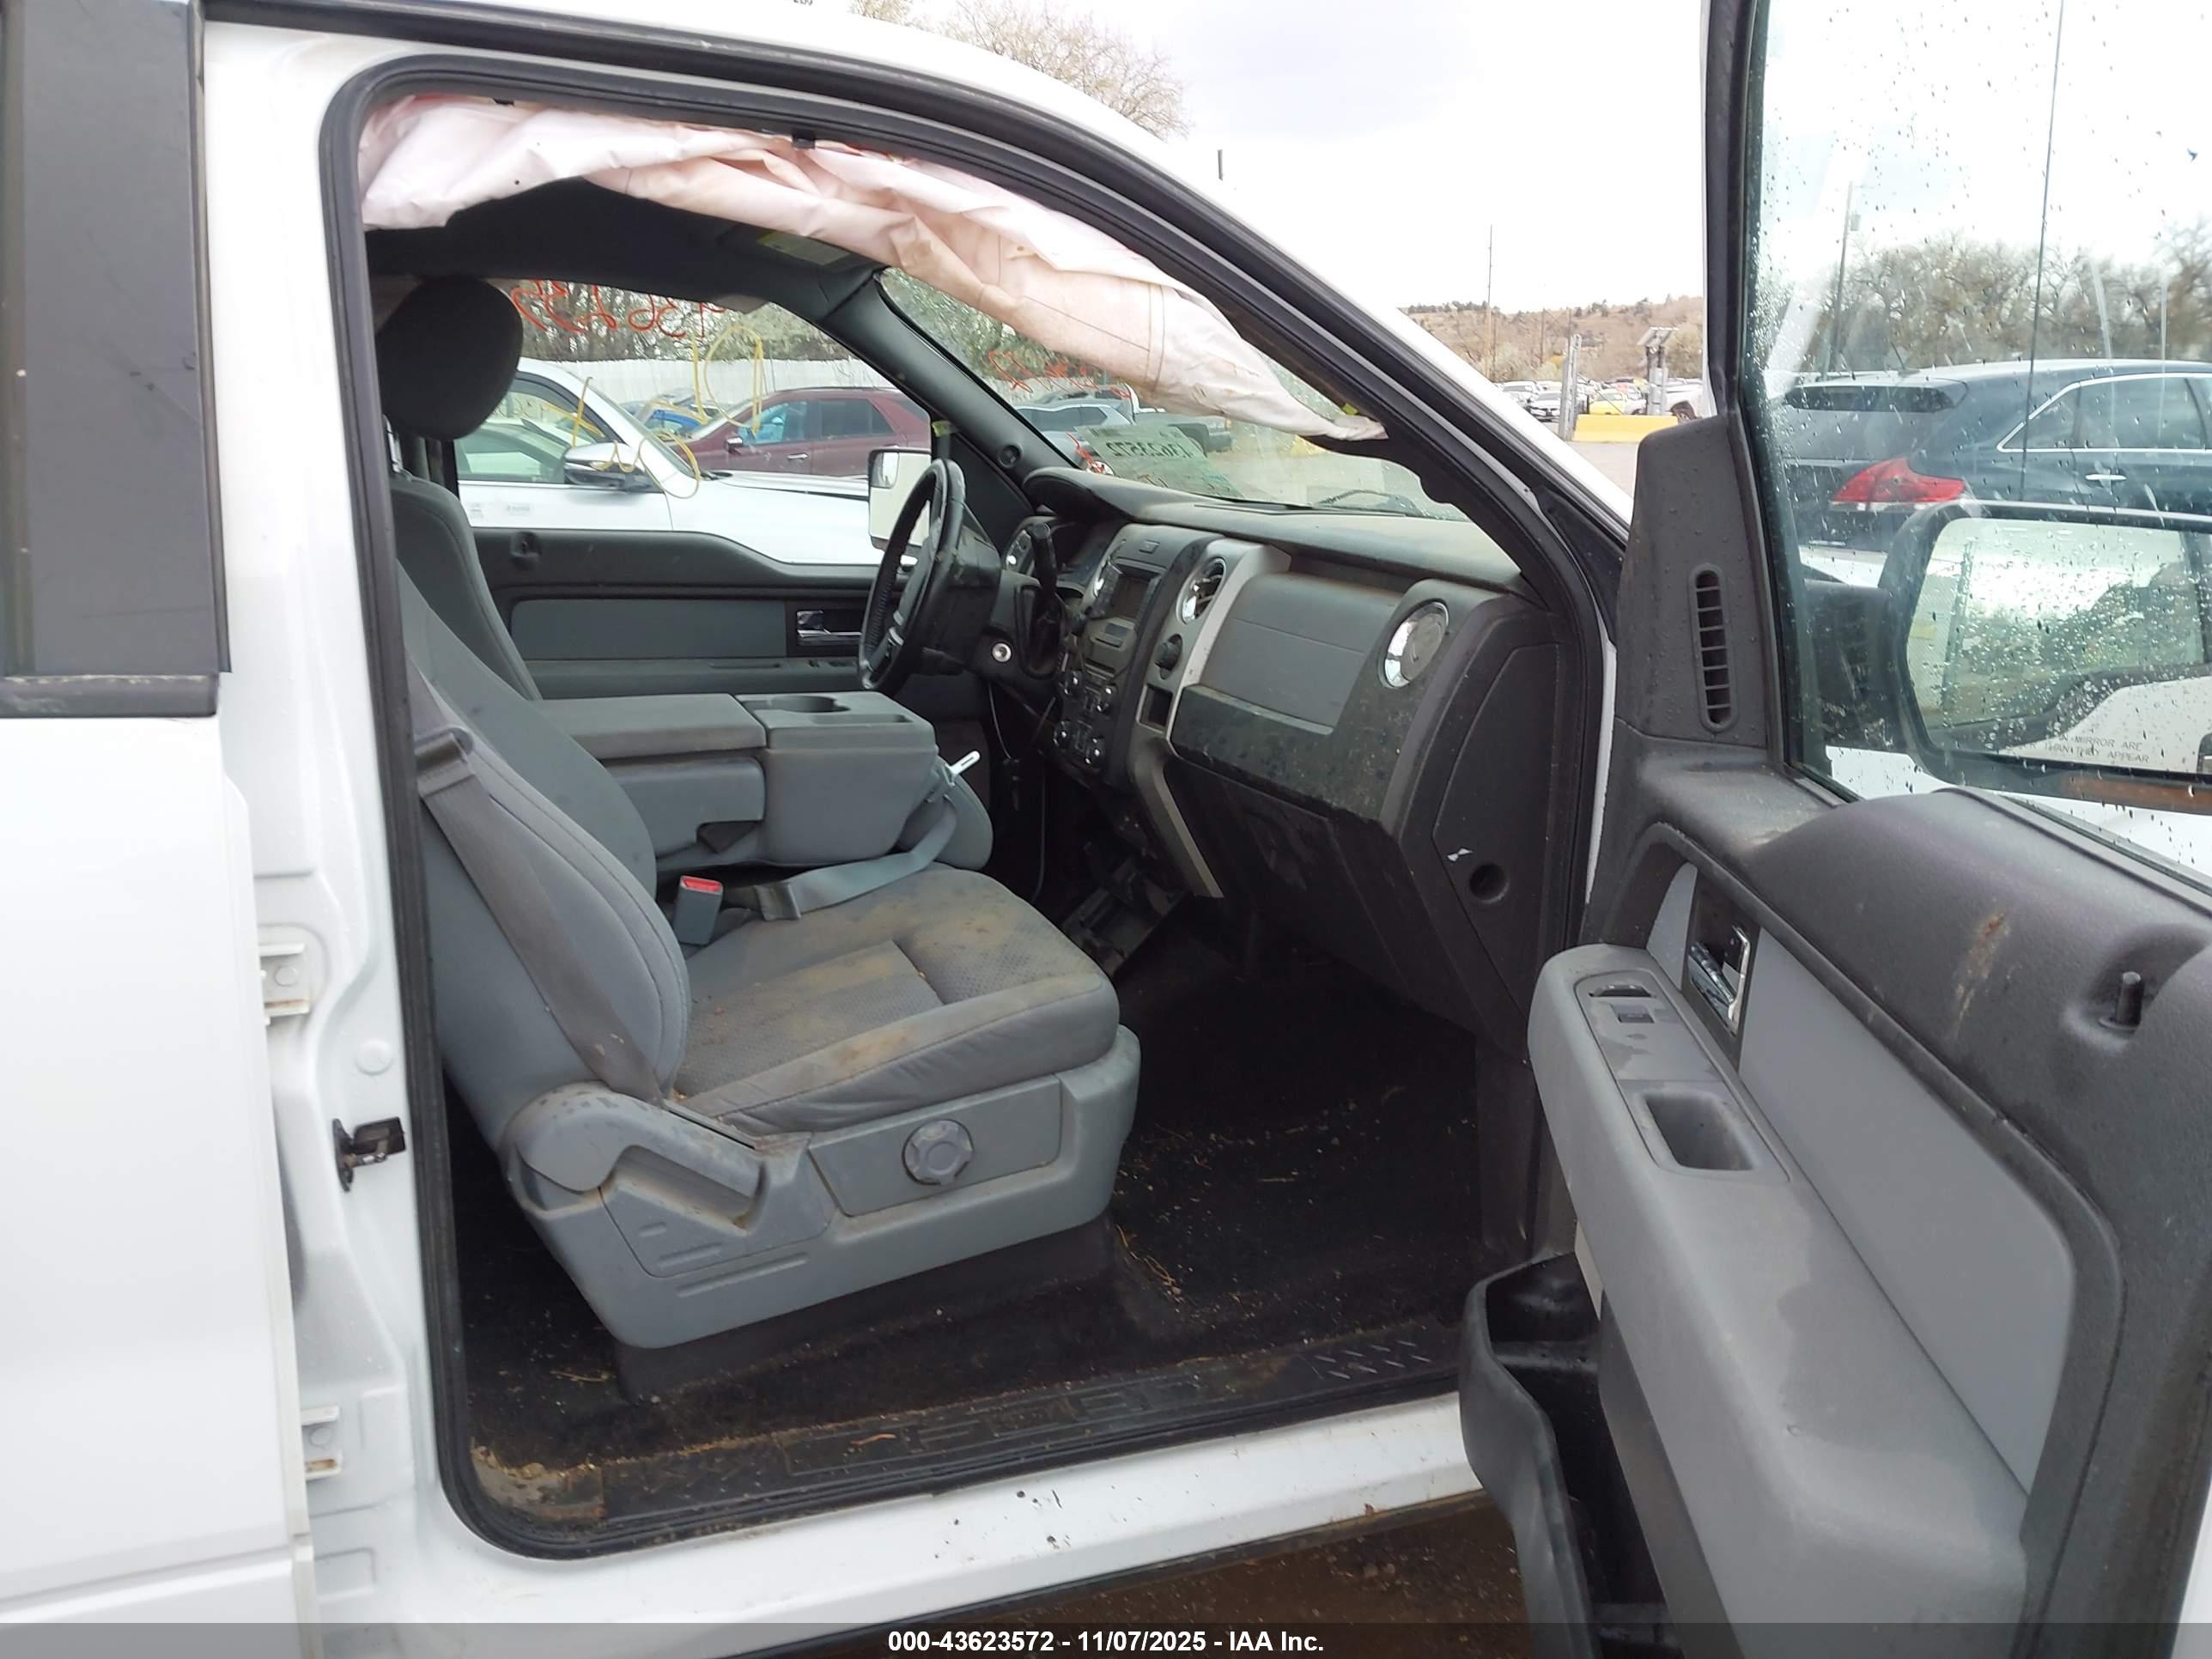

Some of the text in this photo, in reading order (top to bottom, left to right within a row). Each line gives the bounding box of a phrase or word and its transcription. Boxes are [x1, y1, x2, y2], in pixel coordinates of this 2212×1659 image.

[2073, 735, 2116, 748] MIRROR
[2122, 741, 2143, 751] ARE
[2108, 750, 2150, 763] APPEAR
